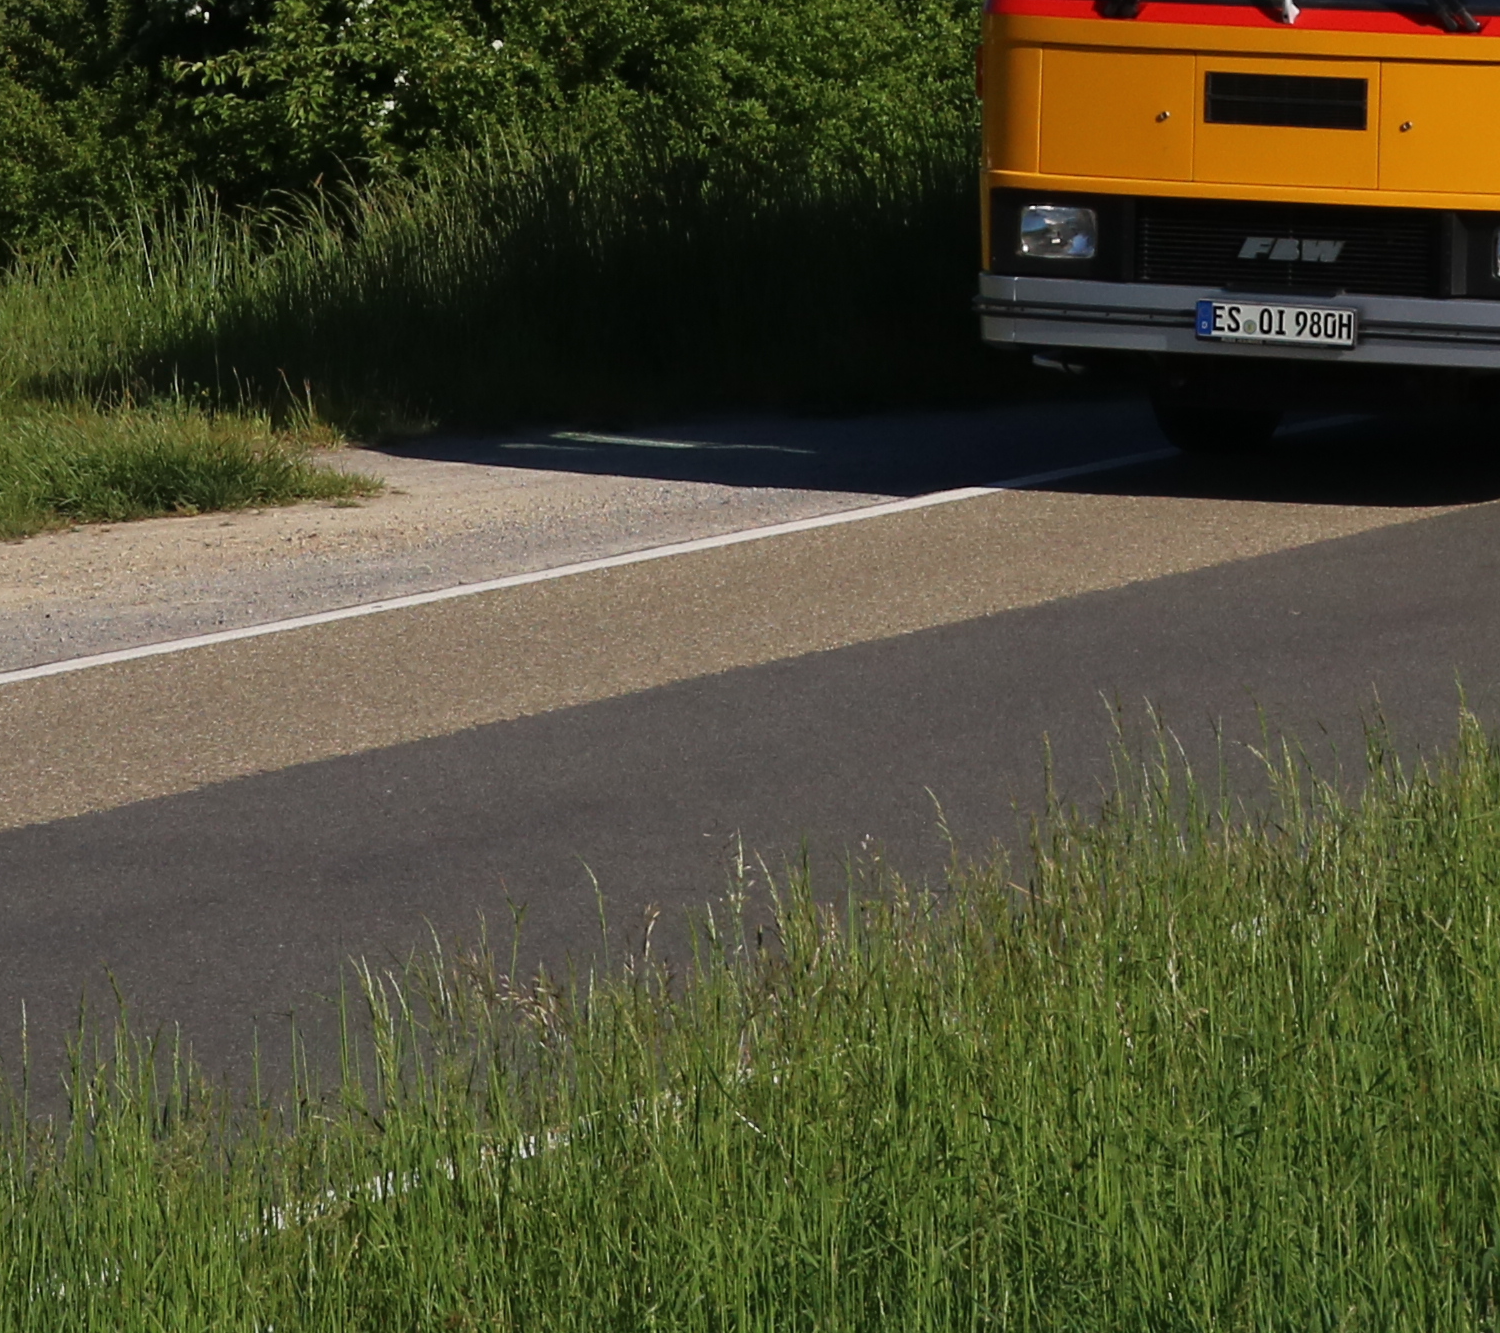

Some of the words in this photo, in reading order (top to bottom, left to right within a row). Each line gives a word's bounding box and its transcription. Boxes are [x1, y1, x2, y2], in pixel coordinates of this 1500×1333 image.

[1238, 237, 1346, 263] FBW
[1212, 305, 1241, 333] ES
[1295, 311, 1352, 340] 980H
